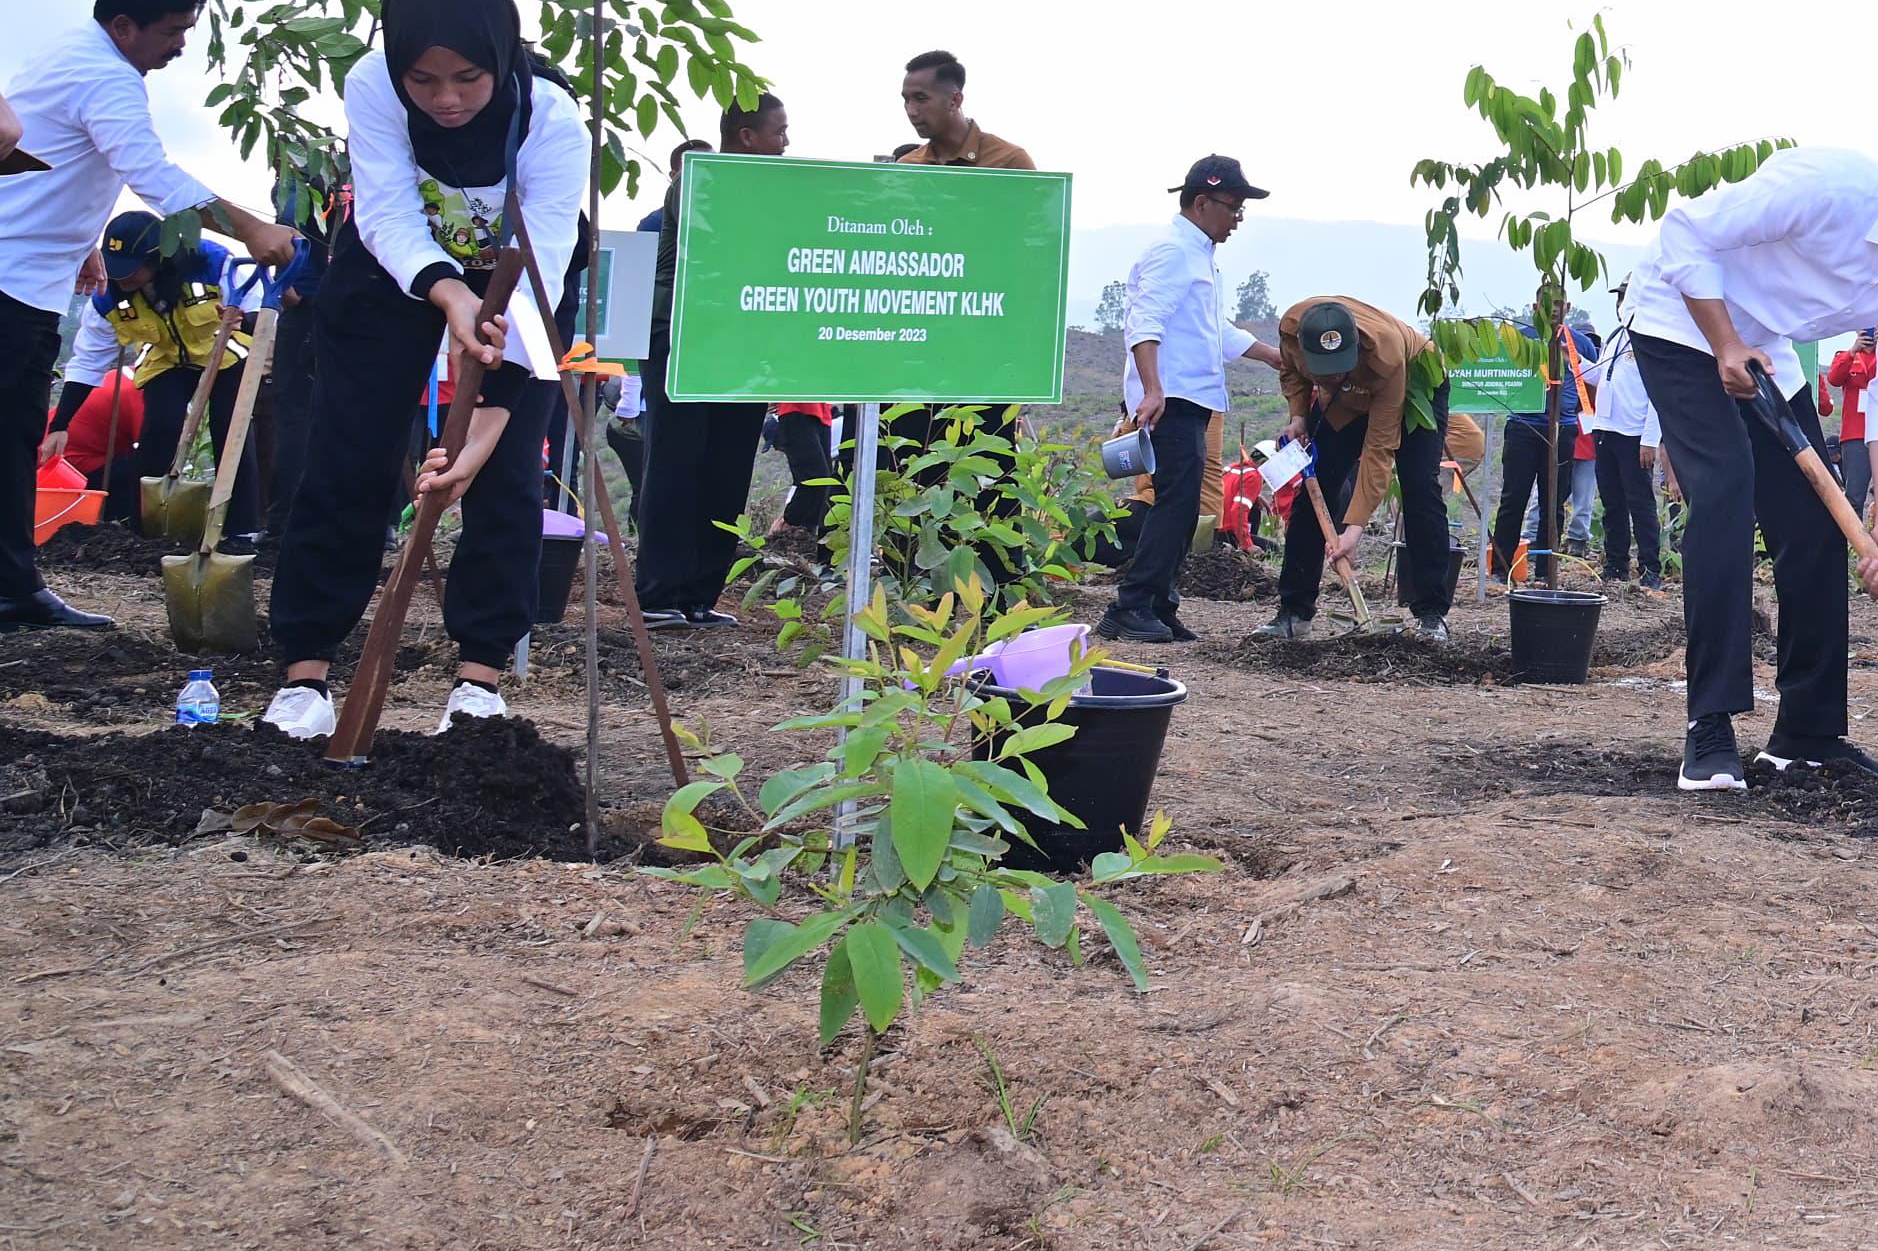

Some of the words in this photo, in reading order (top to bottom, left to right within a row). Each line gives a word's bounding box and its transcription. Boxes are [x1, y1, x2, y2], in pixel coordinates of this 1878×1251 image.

[827, 216, 887, 235] Ditanam
[891, 218, 925, 236] Oleh
[787, 247, 845, 275] GREEN
[849, 249, 965, 278] AMBASSADOR
[740, 285, 799, 313] GREEN
[803, 287, 860, 315] YOUTH
[863, 288, 957, 317] MOVEMENT
[960, 290, 1005, 317] KLHK
[818, 326, 833, 341] 20
[836, 327, 896, 343] Desember
[899, 328, 927, 342] 2023
